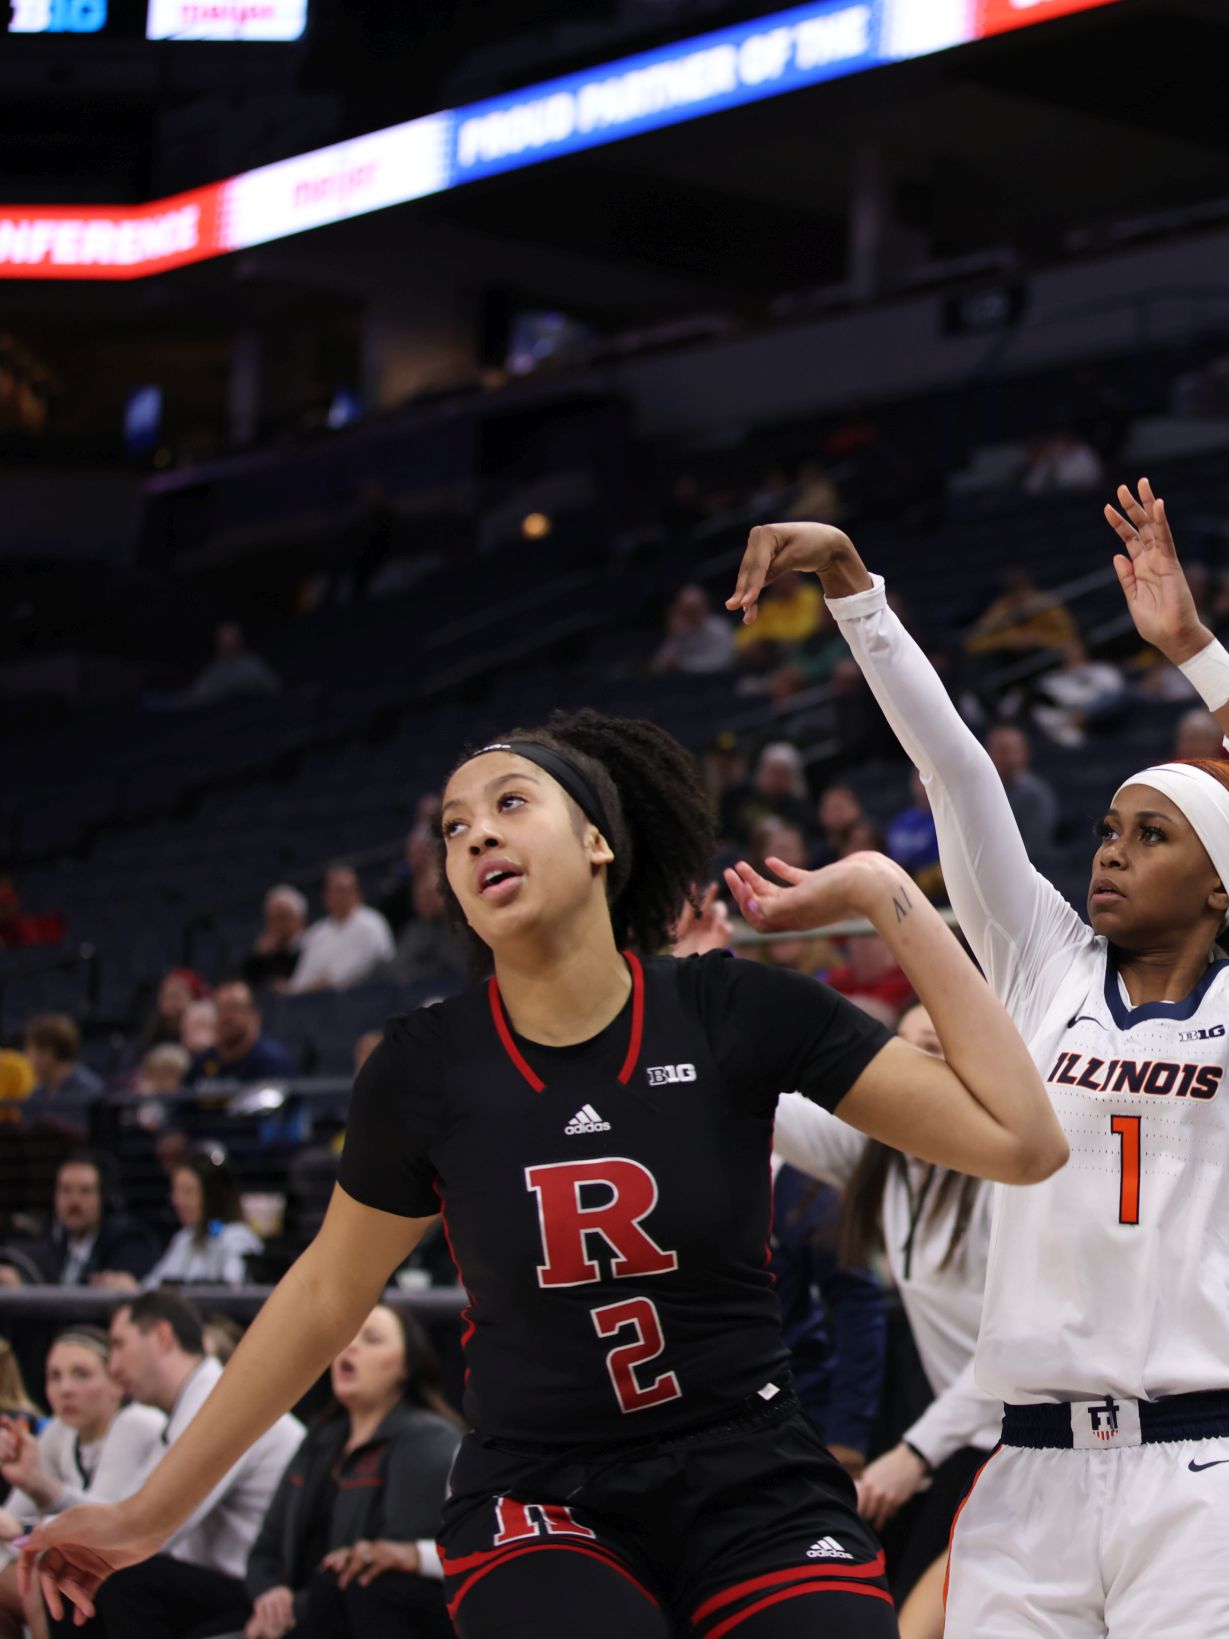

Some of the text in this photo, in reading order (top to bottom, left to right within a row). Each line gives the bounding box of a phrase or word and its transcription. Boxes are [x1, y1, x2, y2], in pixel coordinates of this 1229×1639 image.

[456, 4, 871, 168] PROUD PARTNER OF THE
[564, 1121, 611, 1135] adidas
[1047, 1051, 1224, 1100] ILLINOIS
[525, 1156, 679, 1289] R
[1110, 1114, 1141, 1225] 1
[590, 1296, 682, 1415] 2
